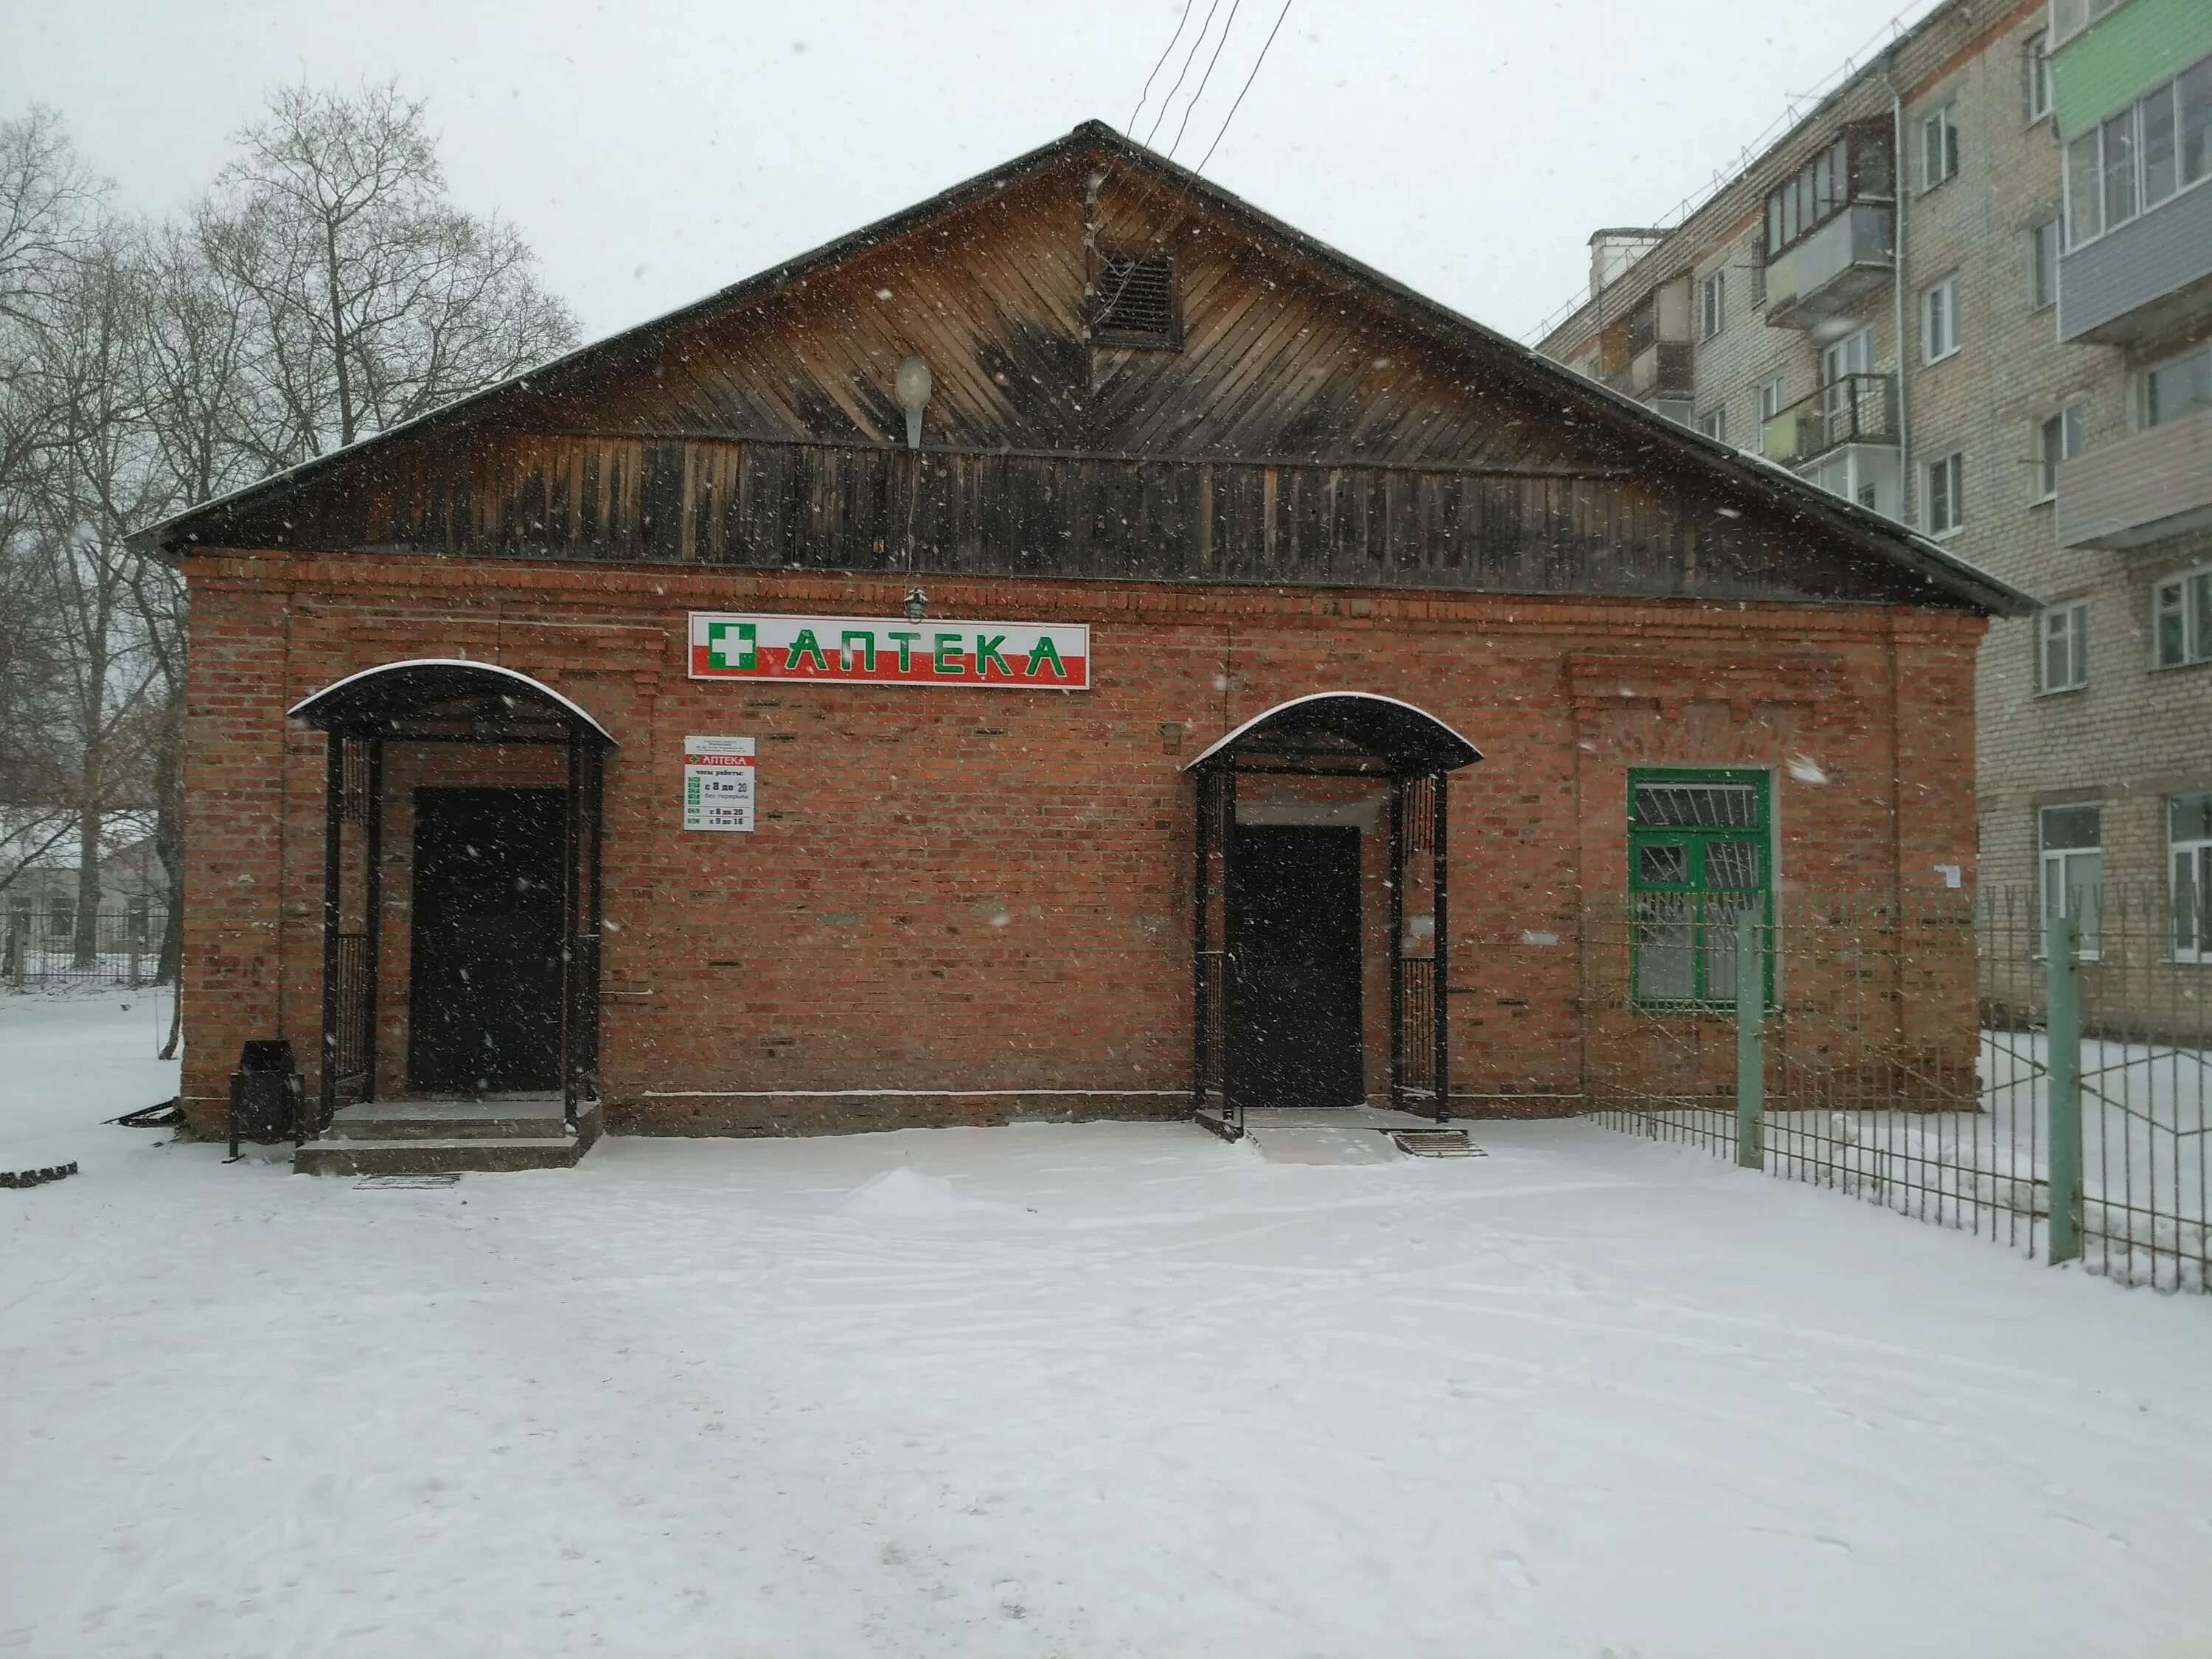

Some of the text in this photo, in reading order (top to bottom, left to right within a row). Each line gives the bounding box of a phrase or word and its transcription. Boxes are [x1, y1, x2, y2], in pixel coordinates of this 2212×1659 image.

[785, 629, 1068, 677] АПТЕКА
[703, 755, 747, 766] АПТЕКА
[713, 782, 719, 790] 8
[738, 783, 747, 792] 20
